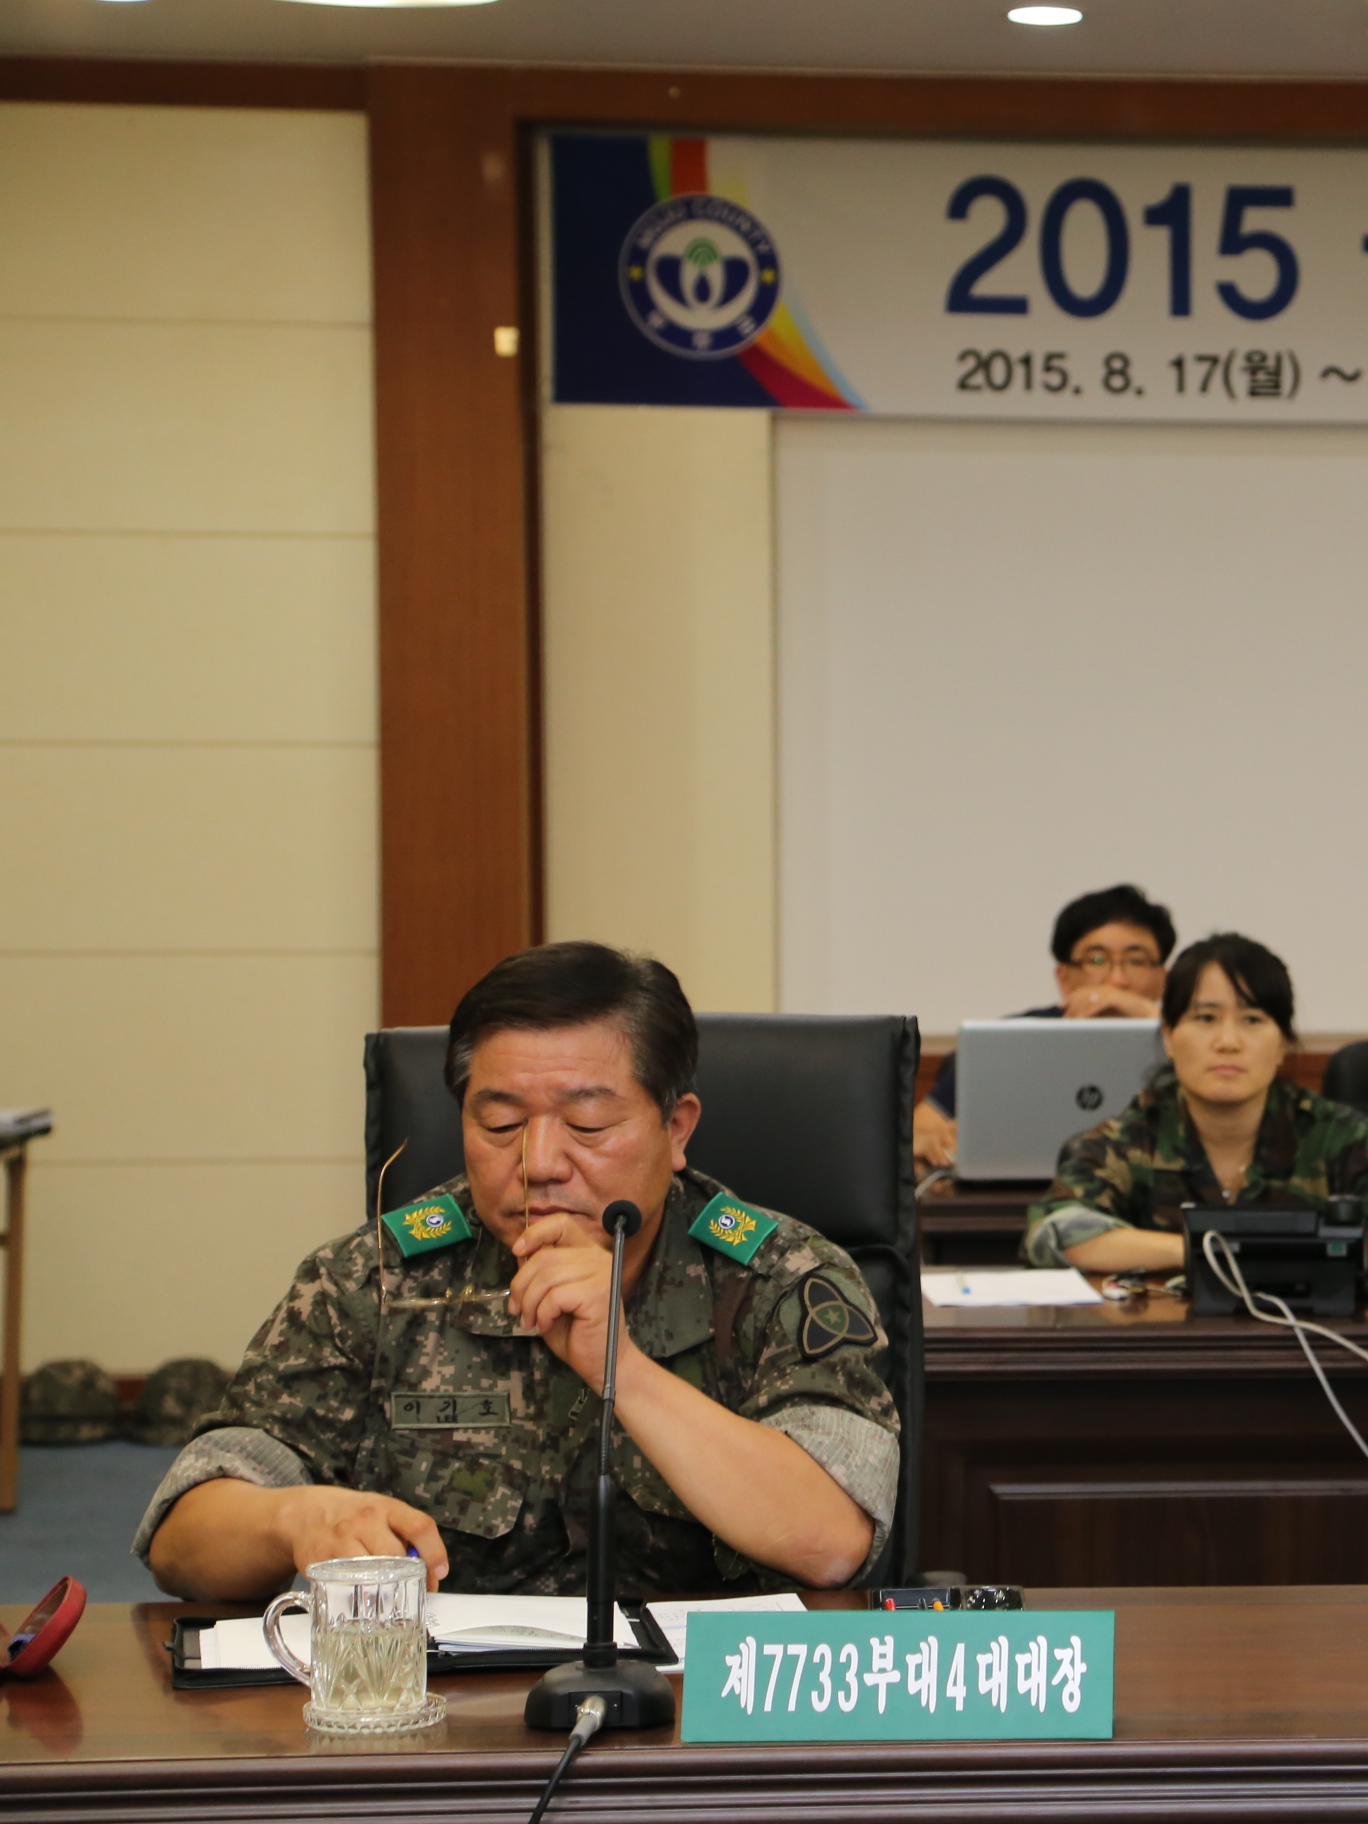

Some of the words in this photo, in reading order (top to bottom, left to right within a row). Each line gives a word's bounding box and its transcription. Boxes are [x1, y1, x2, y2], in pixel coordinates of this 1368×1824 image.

[946, 174, 1300, 321] 2015
[956, 348, 1082, 396] 2015.
[1102, 351, 1144, 397] 8.
[1169, 349, 1301, 399] 17(월)
[721, 1635, 1088, 1716] 제7733부대4대대장
